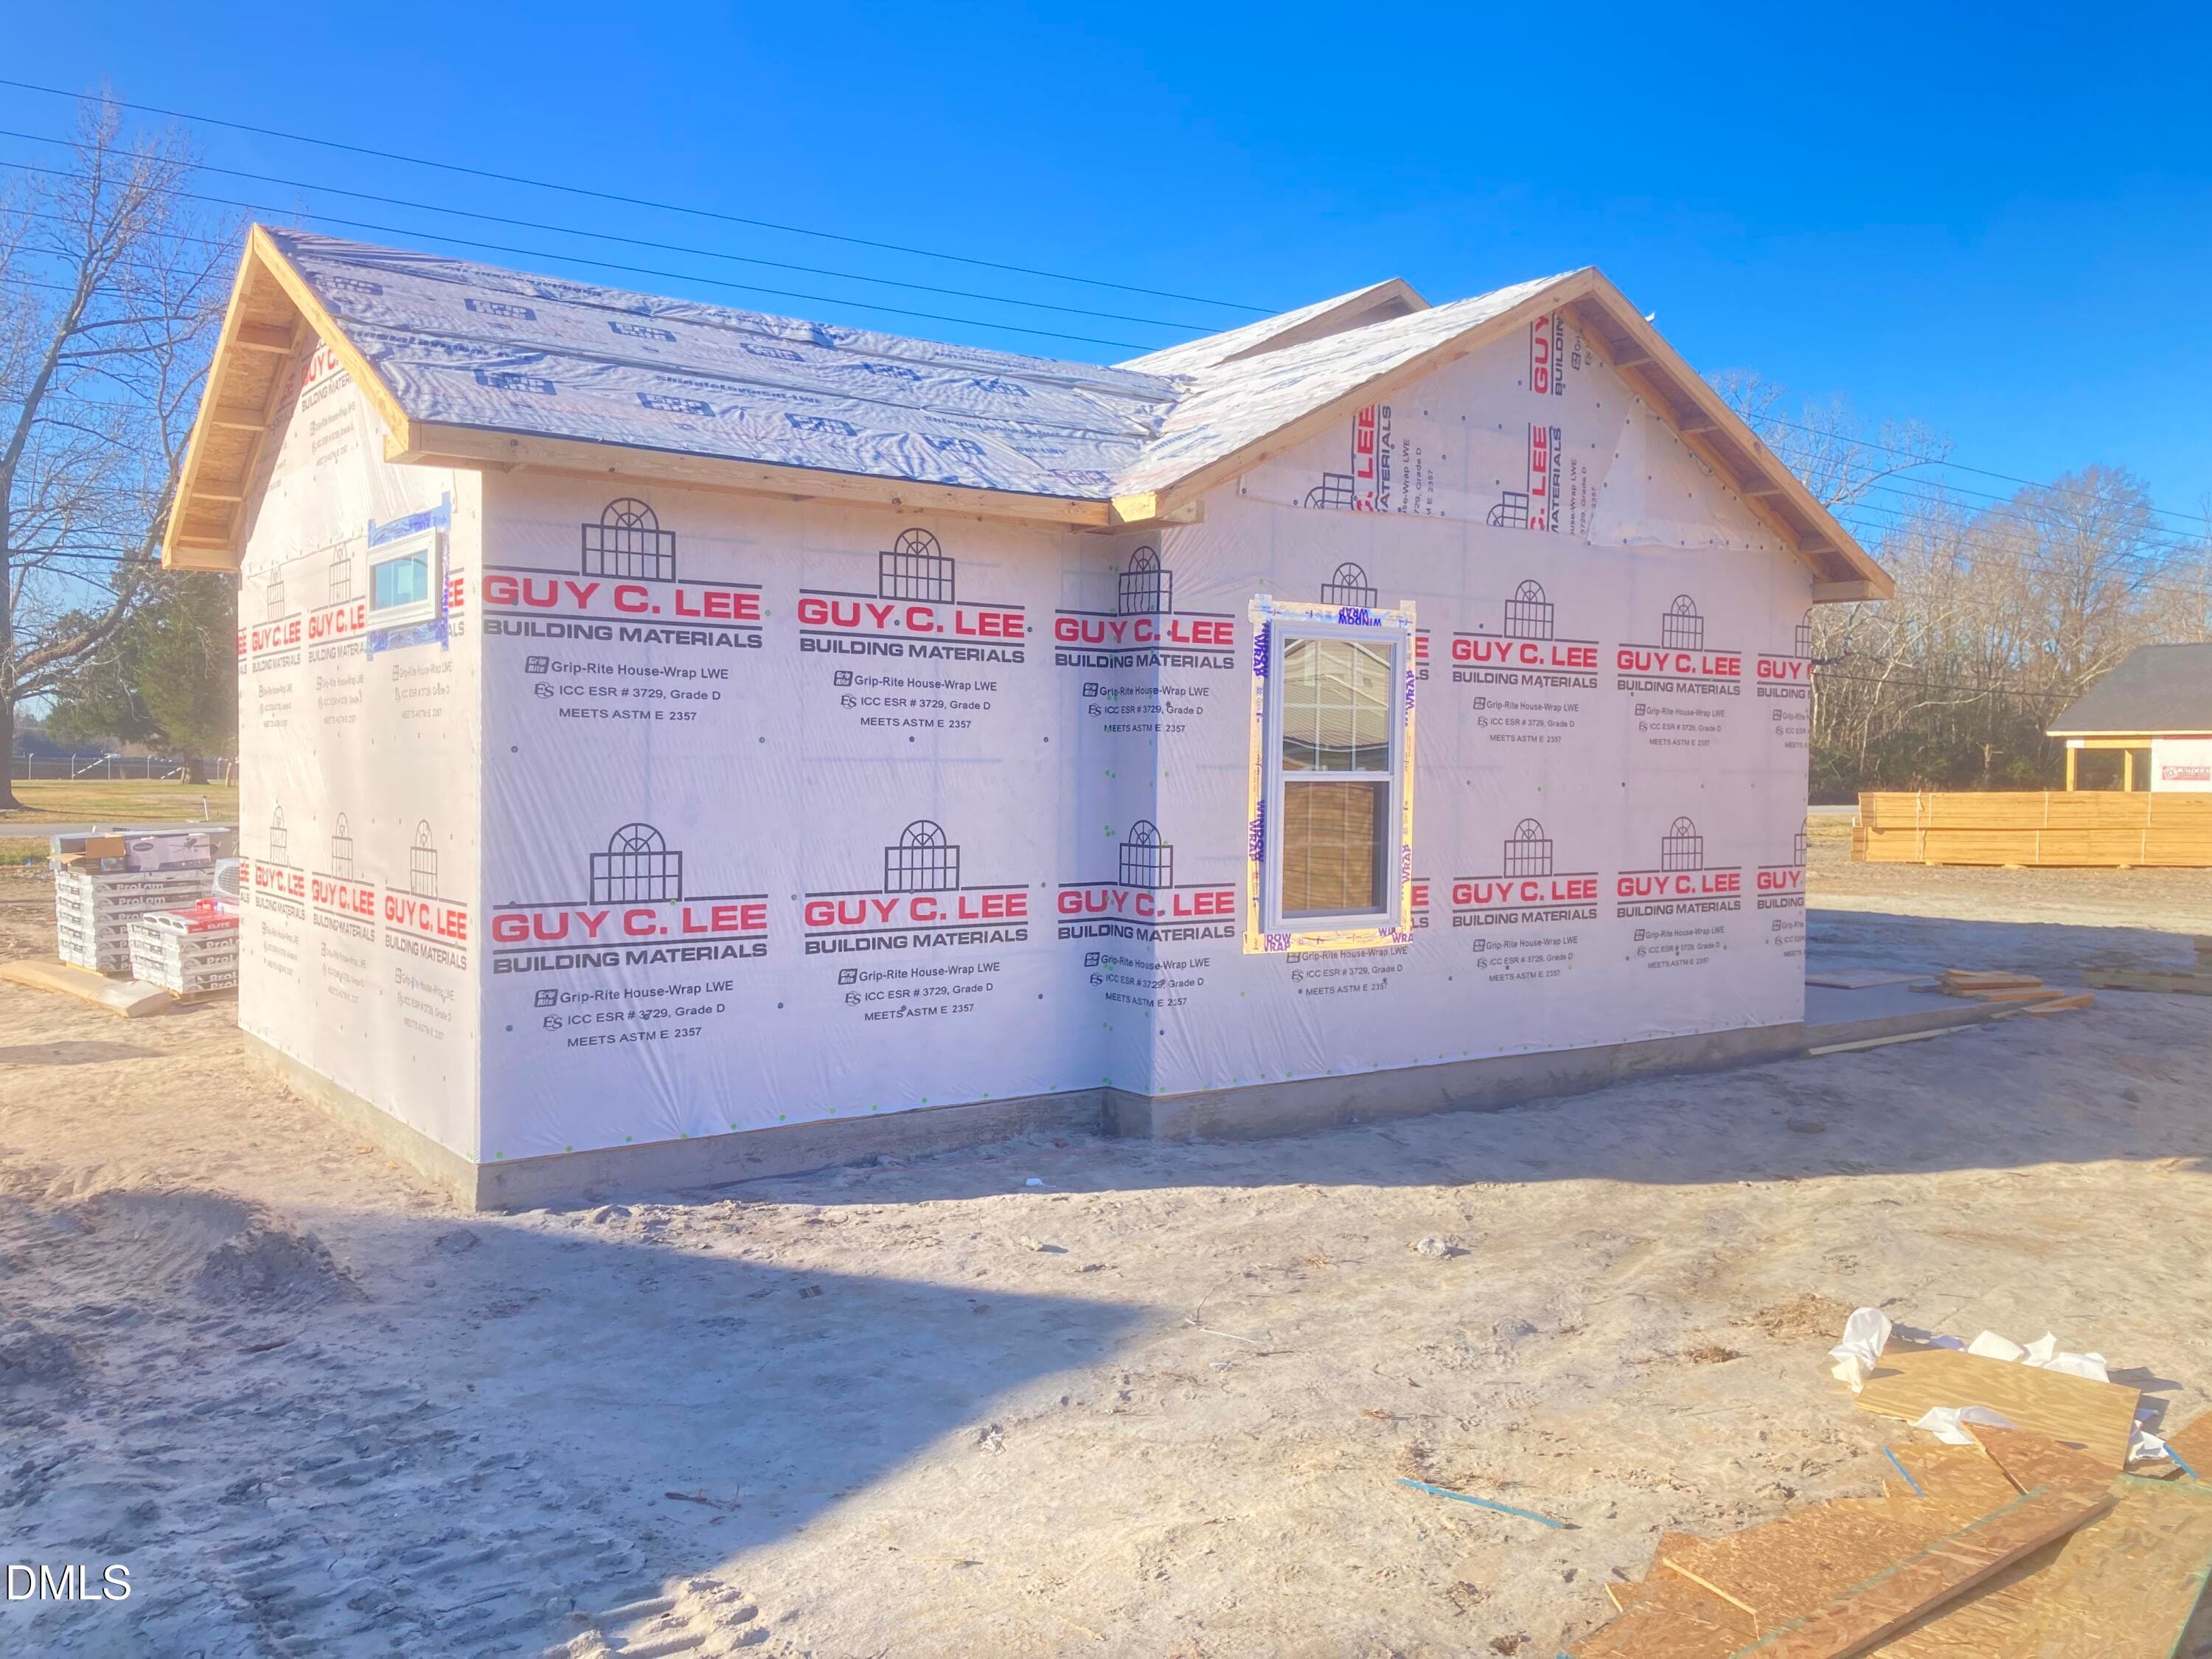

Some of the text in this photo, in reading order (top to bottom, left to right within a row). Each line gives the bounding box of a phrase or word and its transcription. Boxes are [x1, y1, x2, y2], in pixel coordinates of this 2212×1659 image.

[1555, 318, 1564, 395] BUILDIN
[1357, 403, 1374, 479] LEE
[1380, 406, 1391, 512] ATERIALS
[1532, 426, 1547, 496] LEE
[482, 575, 760, 620] GUY C. LEE
[309, 605, 365, 639] GUY C. LE
[798, 598, 1025, 638] GUY C. LEE
[1338, 614, 1382, 627] WINDOW
[1339, 607, 1370, 619] WRAP
[252, 621, 301, 651] GUY C. LEE
[483, 619, 762, 648] BUILDING MATERIALS
[1055, 618, 1234, 644] GUY C. LEE
[309, 641, 368, 663] BUILDING MATERIAL
[800, 638, 1024, 663] BUILDING MATERIALS
[1055, 653, 1234, 669] BUILDING MATERIALS
[1452, 639, 1598, 667] GUY C. LEE
[252, 653, 301, 672] BUILDING MATERIALS
[552, 661, 728, 680] Grip-Rite House-Wrap LWE
[1617, 650, 1741, 676] GUY C. LEE
[1757, 660, 1802, 679] GUY
[855, 675, 997, 691] Grip-Rite House-Wrap LWE
[1453, 671, 1598, 688] BUILDING MATERIALS
[1618, 680, 1740, 695] BUILDING MATERIALS
[560, 686, 584, 695] ICC
[589, 687, 617, 697] ESR
[633, 689, 666, 700] 3729,
[670, 690, 708, 700] Grade
[712, 691, 720, 700] D
[1100, 686, 1209, 697] Grip-Rite House-Wrap LWE
[1757, 688, 1806, 699] BUILDING
[559, 709, 697, 720] MEETS ASTM E 2357
[861, 698, 880, 706] ICC
[885, 698, 907, 706] ESR
[919, 700, 947, 709] 3729,
[950, 700, 981, 709] Grade
[1486, 700, 1519, 711] Grip-Rite
[1520, 703, 1562, 712] House-Wrap
[860, 717, 900, 726] MEETS
[902, 719, 934, 727] ASTM
[949, 720, 971, 728] 2357
[255, 866, 305, 897] GUY C. LEE
[1453, 879, 1598, 905] GUY C. LEE
[1617, 873, 1740, 897] GUY C. LEE
[1757, 871, 1801, 890] GUY
[256, 897, 305, 920] BUILDING MATERIALS
[312, 880, 374, 916] GUY C. LEE
[804, 893, 1028, 926] GUY C. LEE
[1058, 890, 1235, 917] GUY C. LEE
[1617, 901, 1741, 917] BUILDING MATERIALS
[1758, 897, 1804, 909] BUILDING
[313, 914, 375, 942] BUILDING MATERIALS
[385, 896, 467, 940] GUY C. LEE
[492, 904, 768, 942] GUY C. LEE
[1453, 909, 1597, 927] BUILDING MATERIALS
[805, 929, 1028, 954] BUILDING MATERIALS
[1058, 925, 1235, 942] BUILDING MATERIALS
[386, 934, 467, 970] BUILDING MATERIALS
[493, 943, 768, 974] BUILDING MATERIALS
[1302, 947, 1408, 961] Grip-Rite House-Wrap LWE
[859, 962, 1000, 982] Grip-Rite House-Wrap LWE
[560, 981, 733, 1004] Grip-Rite House-Wrap LWE
[865, 1004, 974, 1020] MEETS ASTM E 2357
[568, 1027, 701, 1048] MEETS ASTM E 2357
